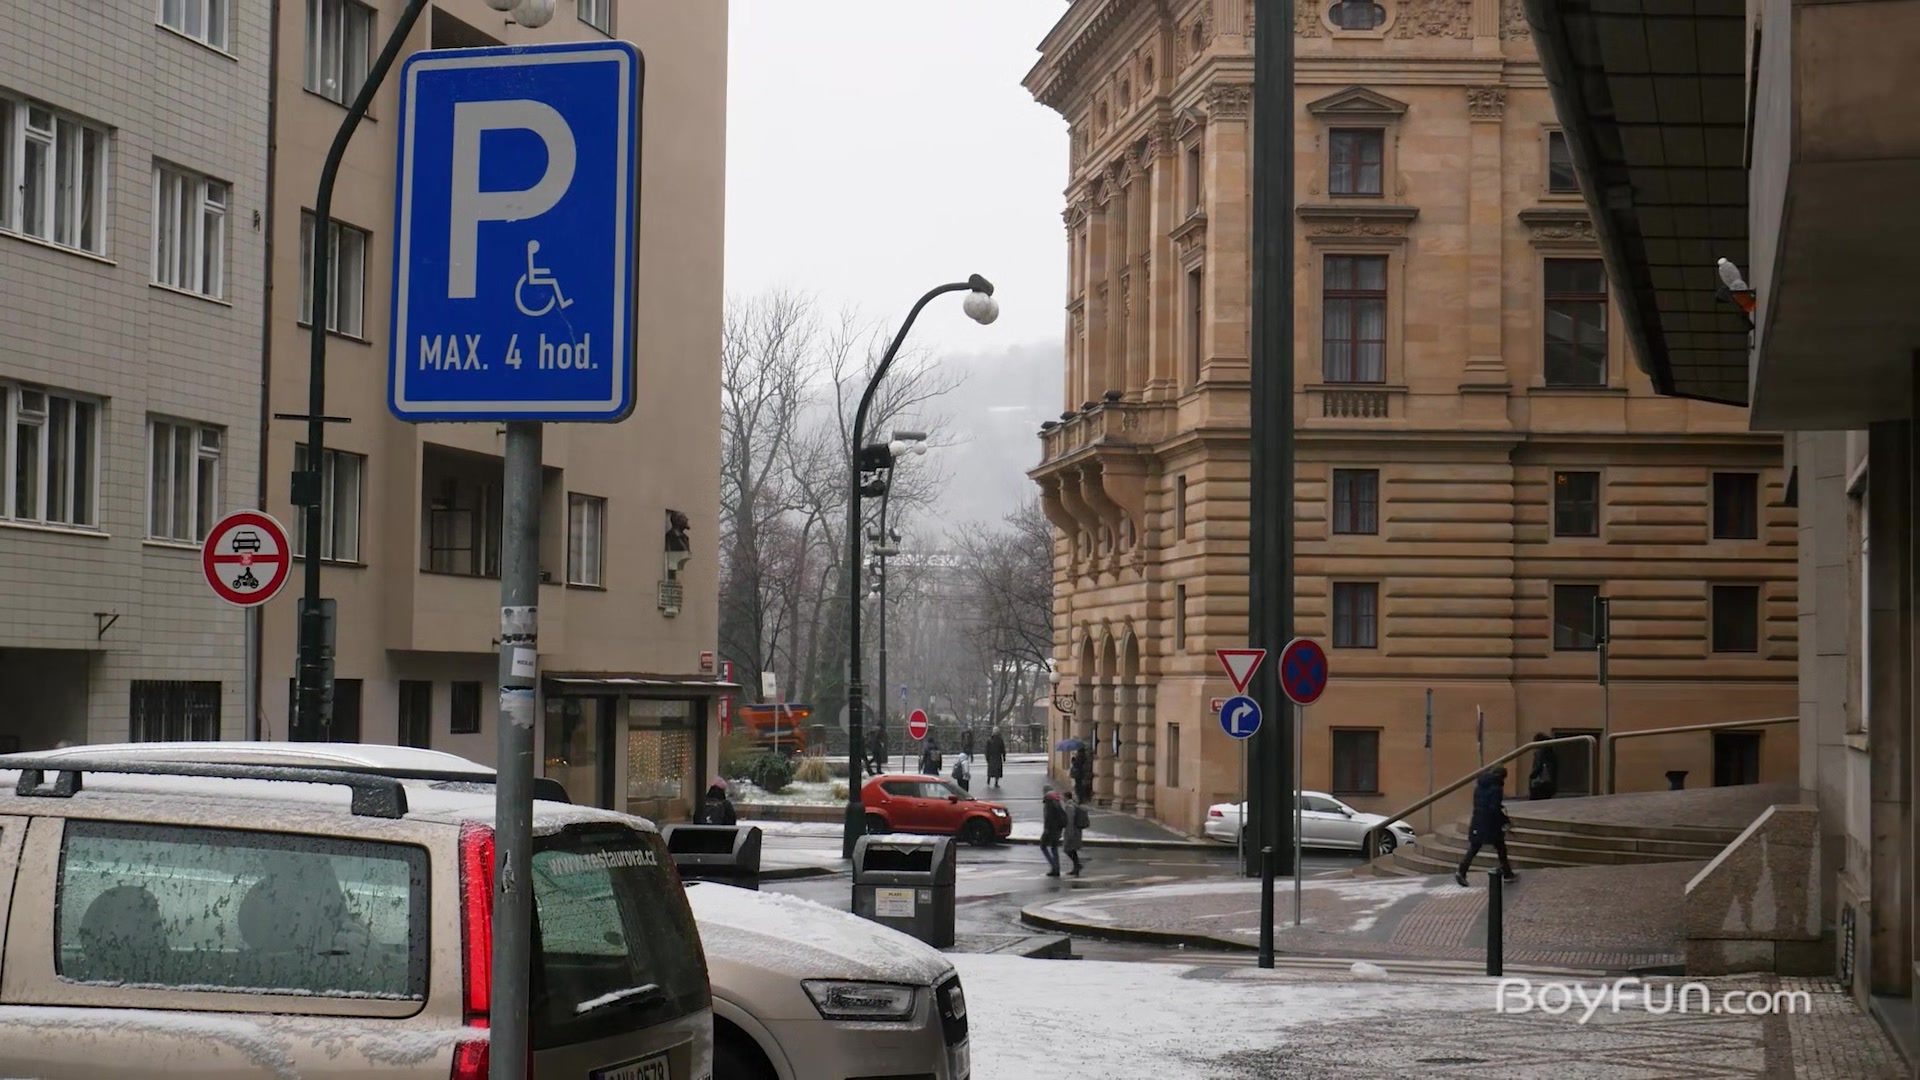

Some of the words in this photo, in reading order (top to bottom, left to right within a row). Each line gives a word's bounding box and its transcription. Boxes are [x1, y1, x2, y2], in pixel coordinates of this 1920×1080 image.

[448, 99, 577, 299] P
[419, 334, 489, 371] MAX.
[505, 333, 522, 370] 4
[539, 332, 598, 370] hod.
[547, 848, 658, 875] www.restaurovat.cz
